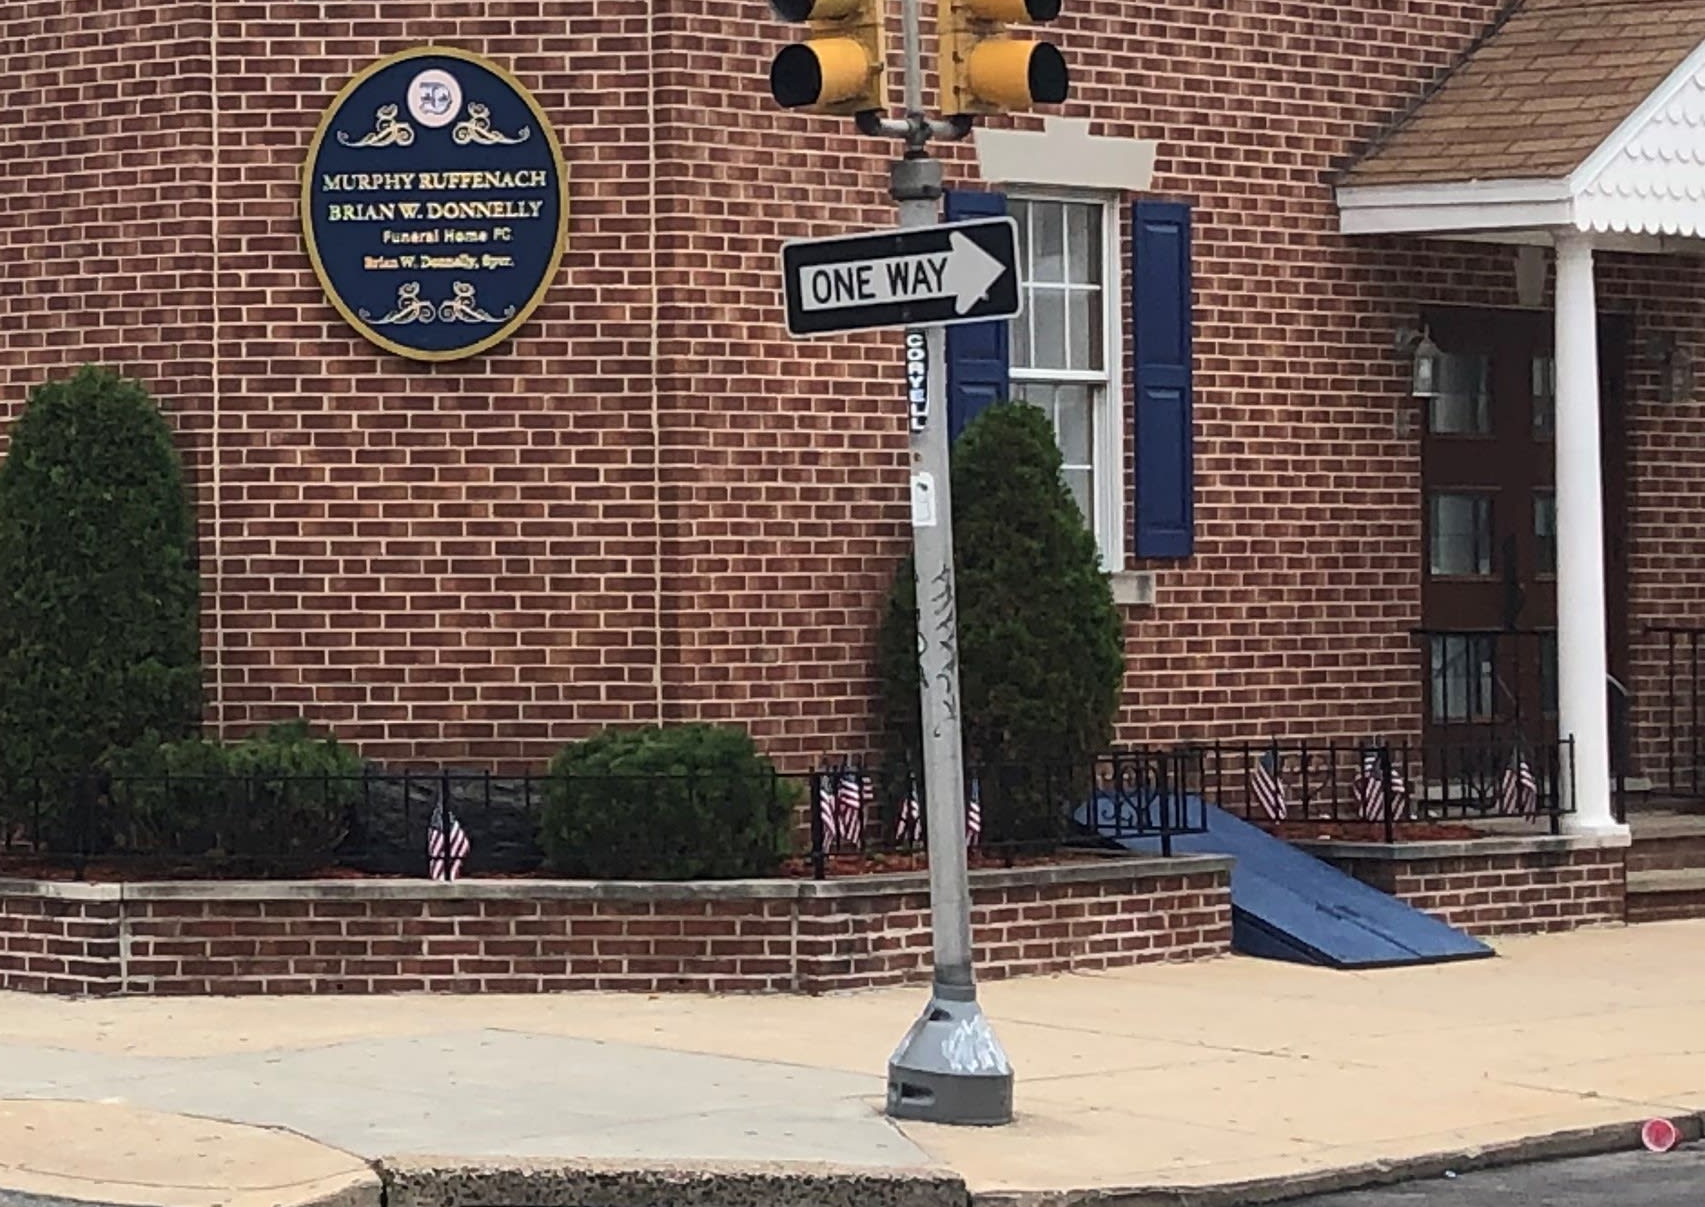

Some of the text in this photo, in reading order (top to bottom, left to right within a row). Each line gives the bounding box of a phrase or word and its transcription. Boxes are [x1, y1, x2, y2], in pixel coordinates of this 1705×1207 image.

[322, 170, 547, 192] MURPHY RUFFENACH
[328, 200, 544, 221] BRIAN W. DONNELLY
[383, 229, 440, 244] Funeral
[443, 228, 488, 242] Home
[363, 255, 399, 270] Brian
[419, 253, 481, 270] Donnelly,
[810, 257, 949, 305] ONE WAY
